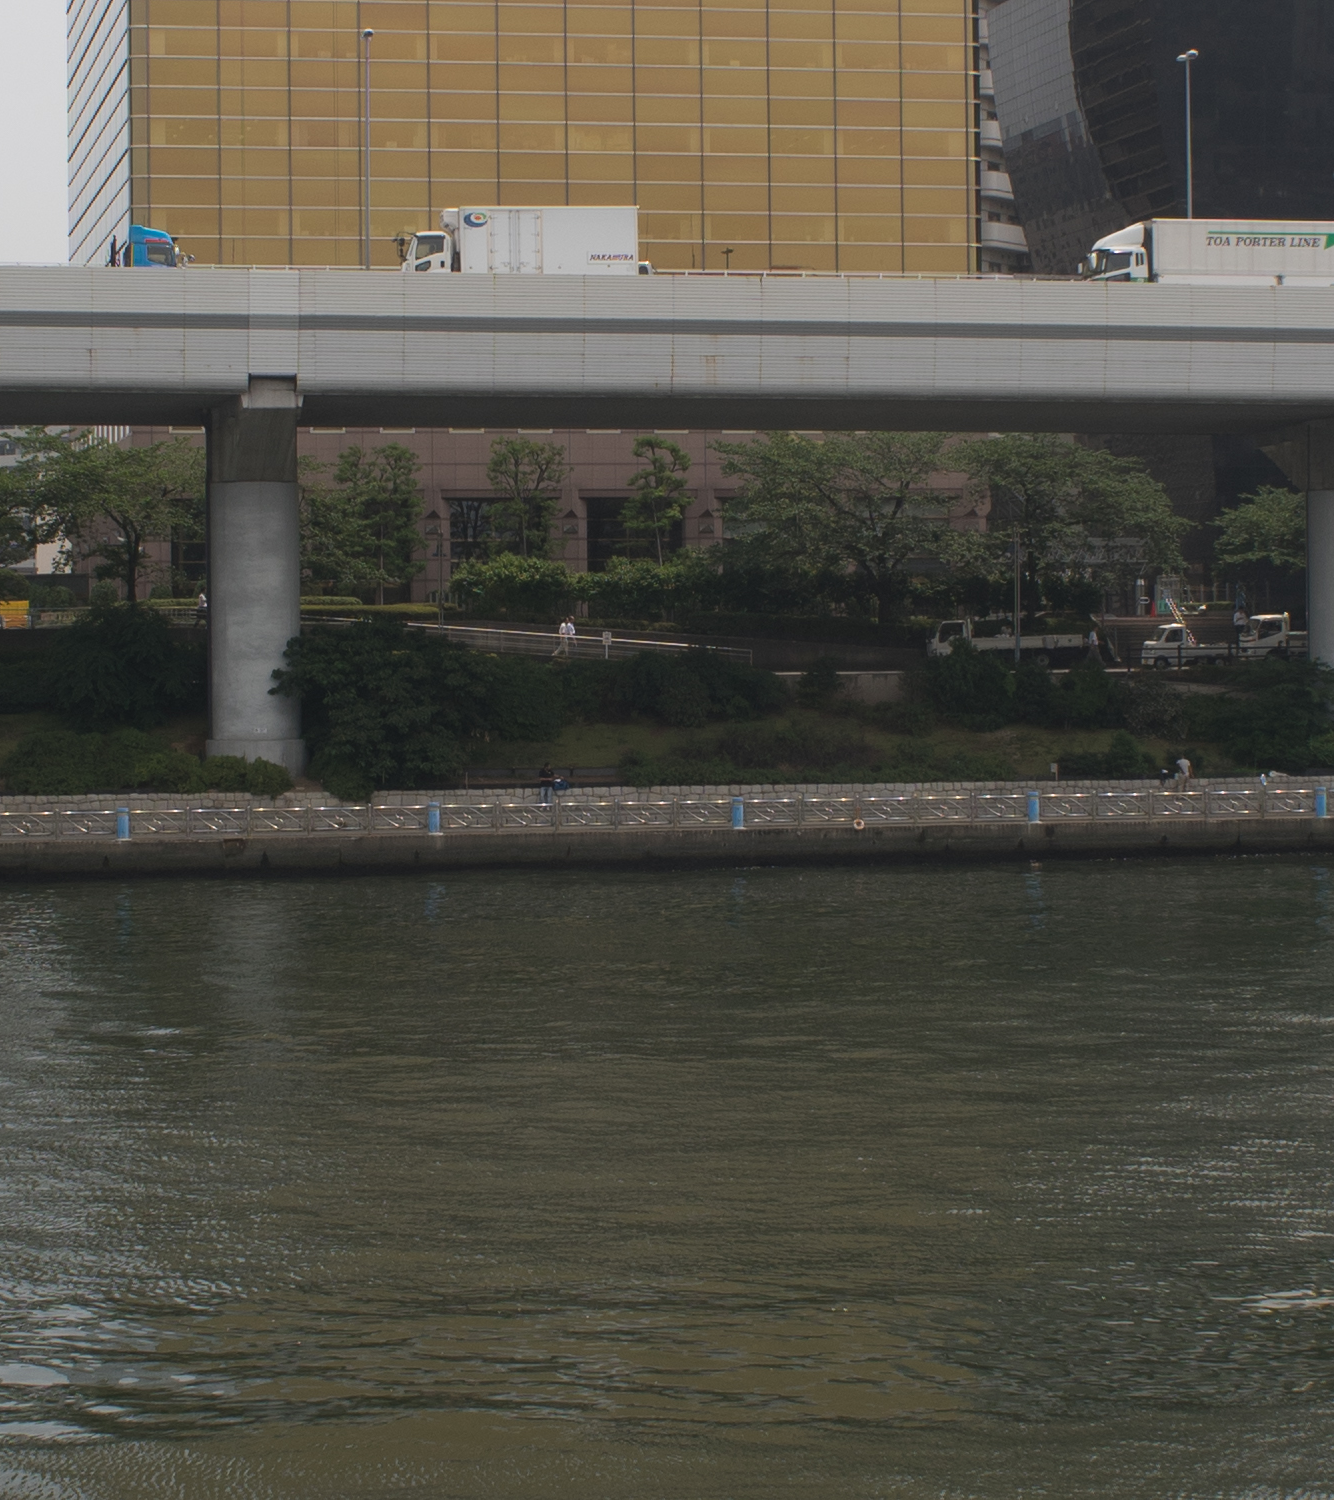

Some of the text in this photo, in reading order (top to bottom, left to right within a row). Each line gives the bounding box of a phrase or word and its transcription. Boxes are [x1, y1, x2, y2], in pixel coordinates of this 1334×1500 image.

[1206, 236, 1321, 248] TOA PORTER LINE
[589, 254, 634, 262] NAKAMURA
